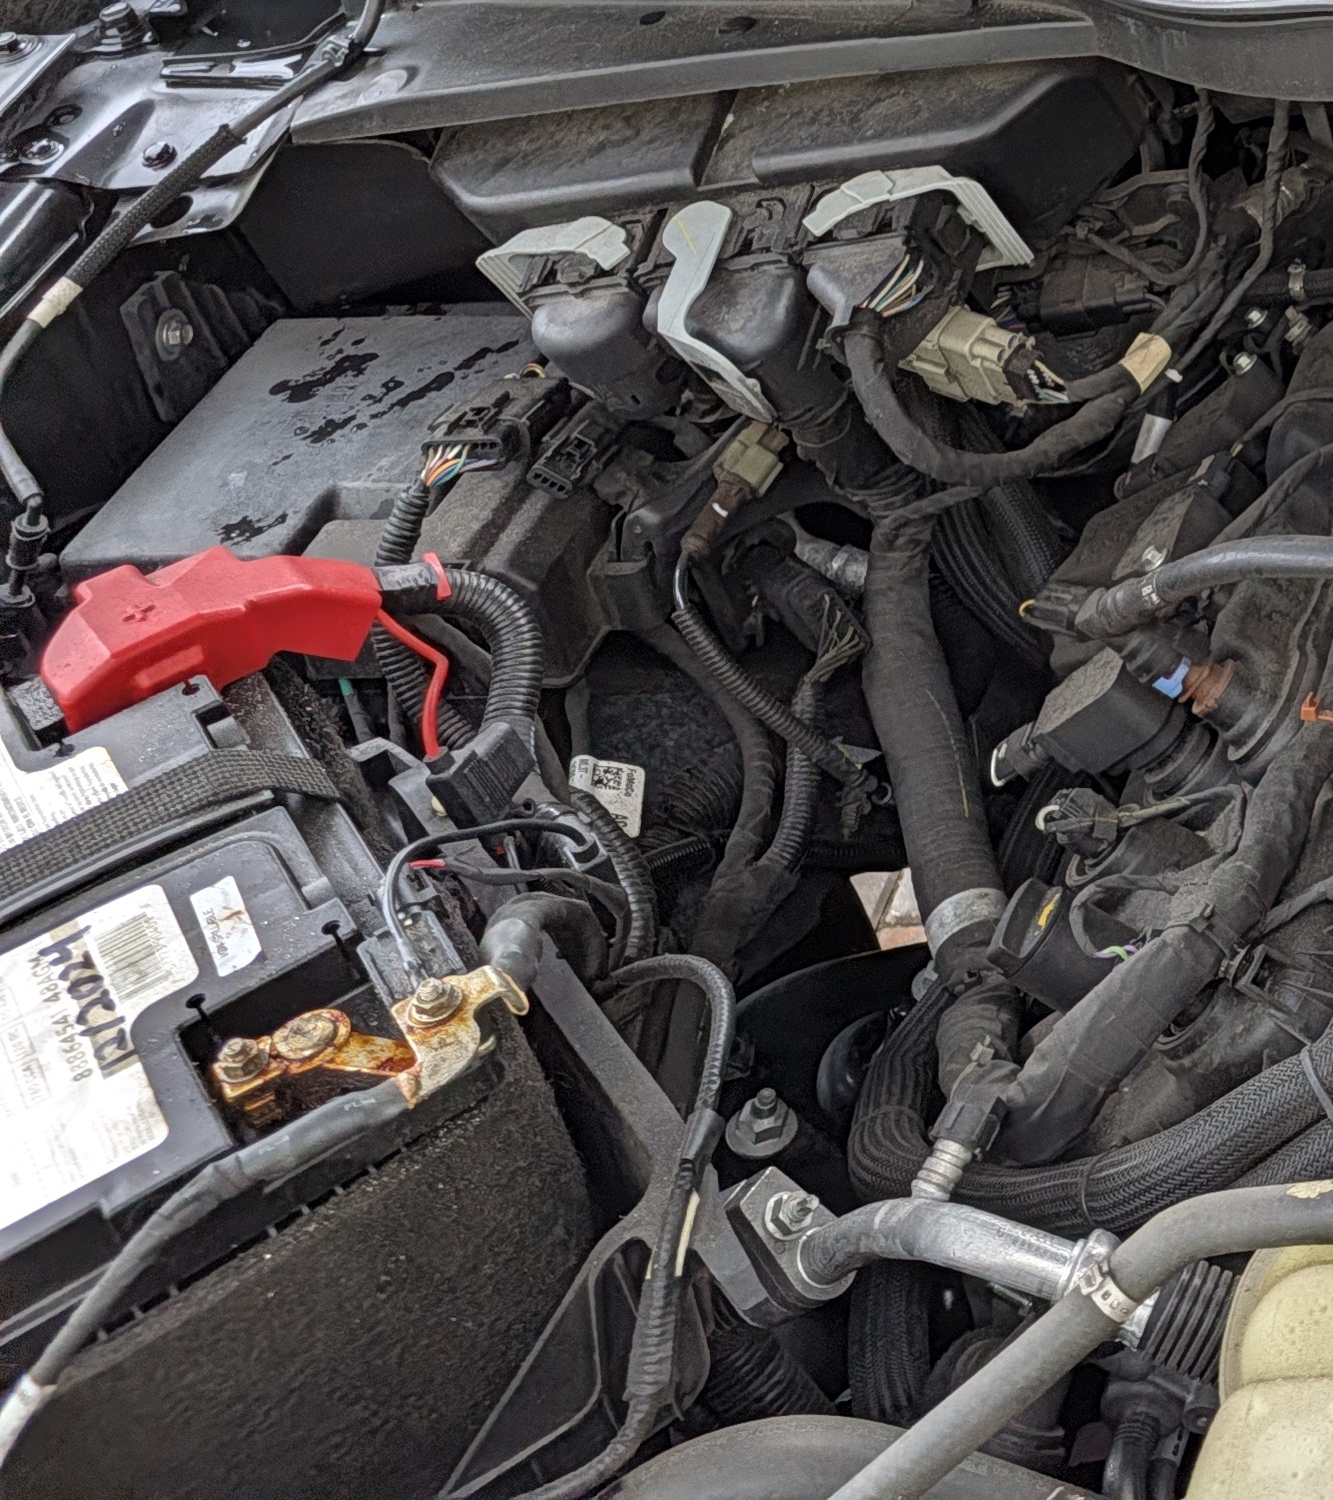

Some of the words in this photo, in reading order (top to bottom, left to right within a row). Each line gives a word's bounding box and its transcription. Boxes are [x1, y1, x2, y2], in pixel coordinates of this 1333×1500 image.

[27, 955, 61, 1003] 48AGM
[36, 924, 138, 1071] 12/2024
[49, 1008, 93, 1082] 88864541
